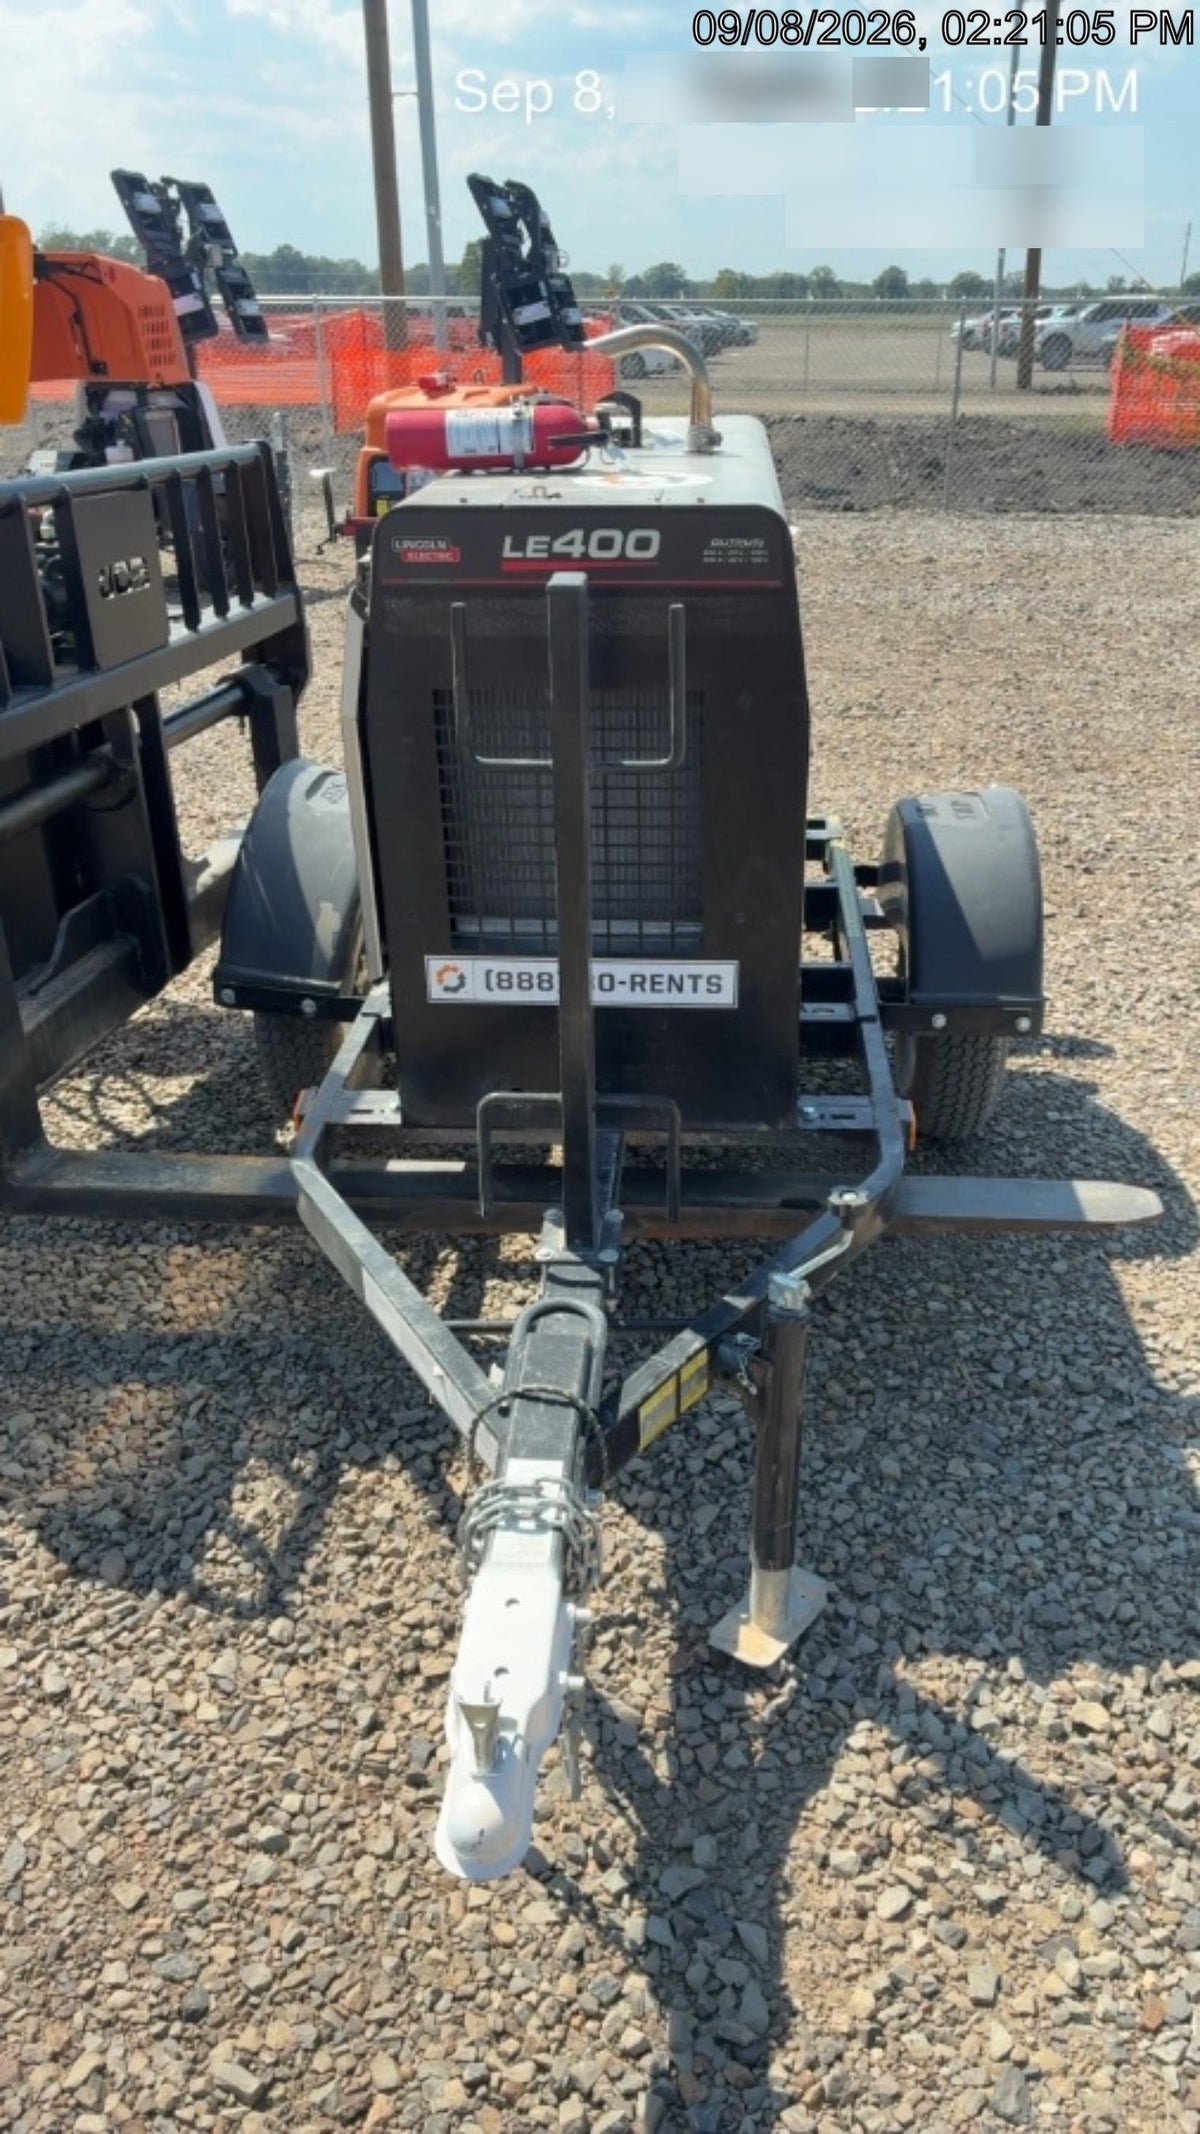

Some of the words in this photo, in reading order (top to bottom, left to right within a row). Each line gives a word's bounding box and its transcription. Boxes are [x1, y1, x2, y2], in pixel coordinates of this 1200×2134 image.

[394, 539, 448, 551] LINCOLN
[502, 528, 661, 559] LE400
[484, 968, 560, 993] (888
[589, 972, 724, 995] 0-RENTS
